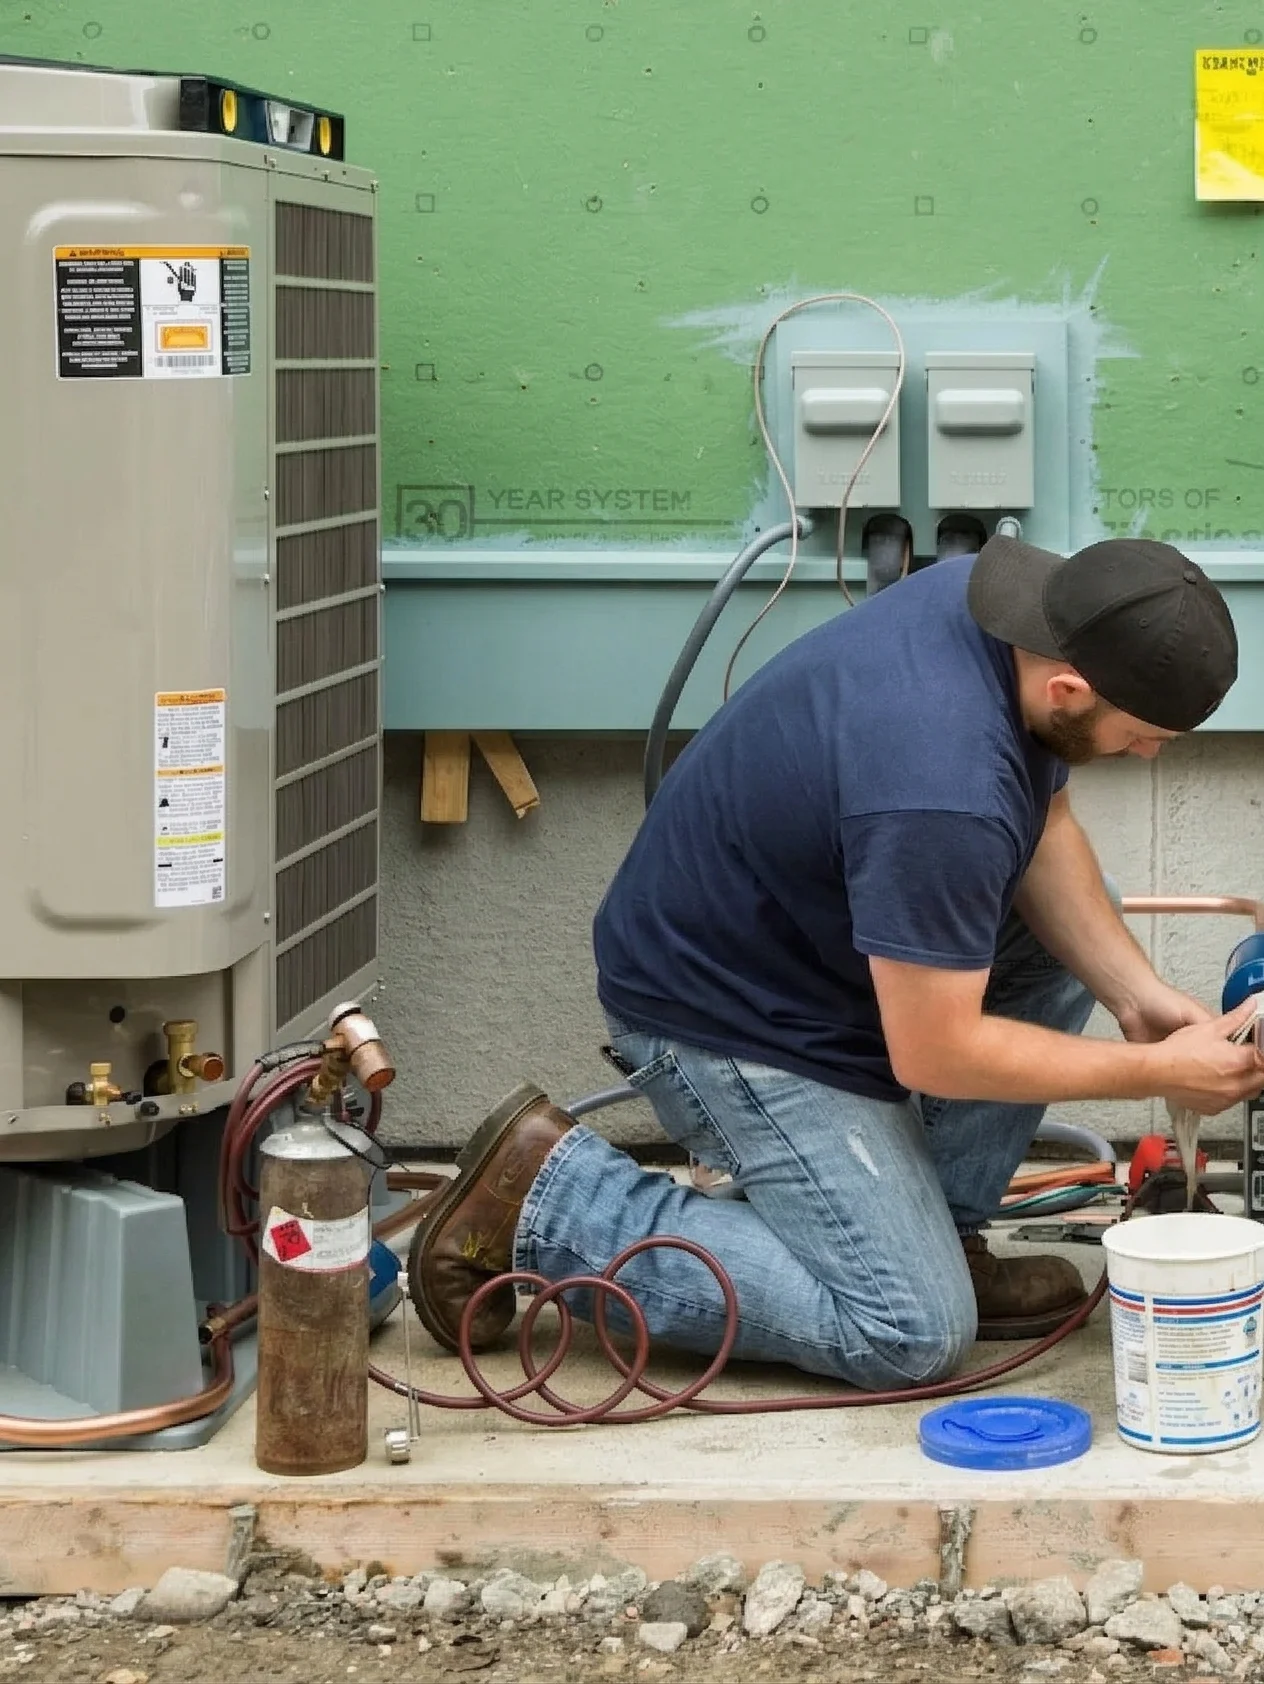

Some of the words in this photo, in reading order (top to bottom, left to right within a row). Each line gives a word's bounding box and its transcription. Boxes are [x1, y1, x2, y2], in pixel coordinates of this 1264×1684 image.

[404, 499, 469, 539] 30
[487, 488, 564, 511] YEAR
[575, 488, 692, 511] SYSTEM
[1100, 487, 1174, 510] TORS
[1184, 487, 1221, 510] OF
